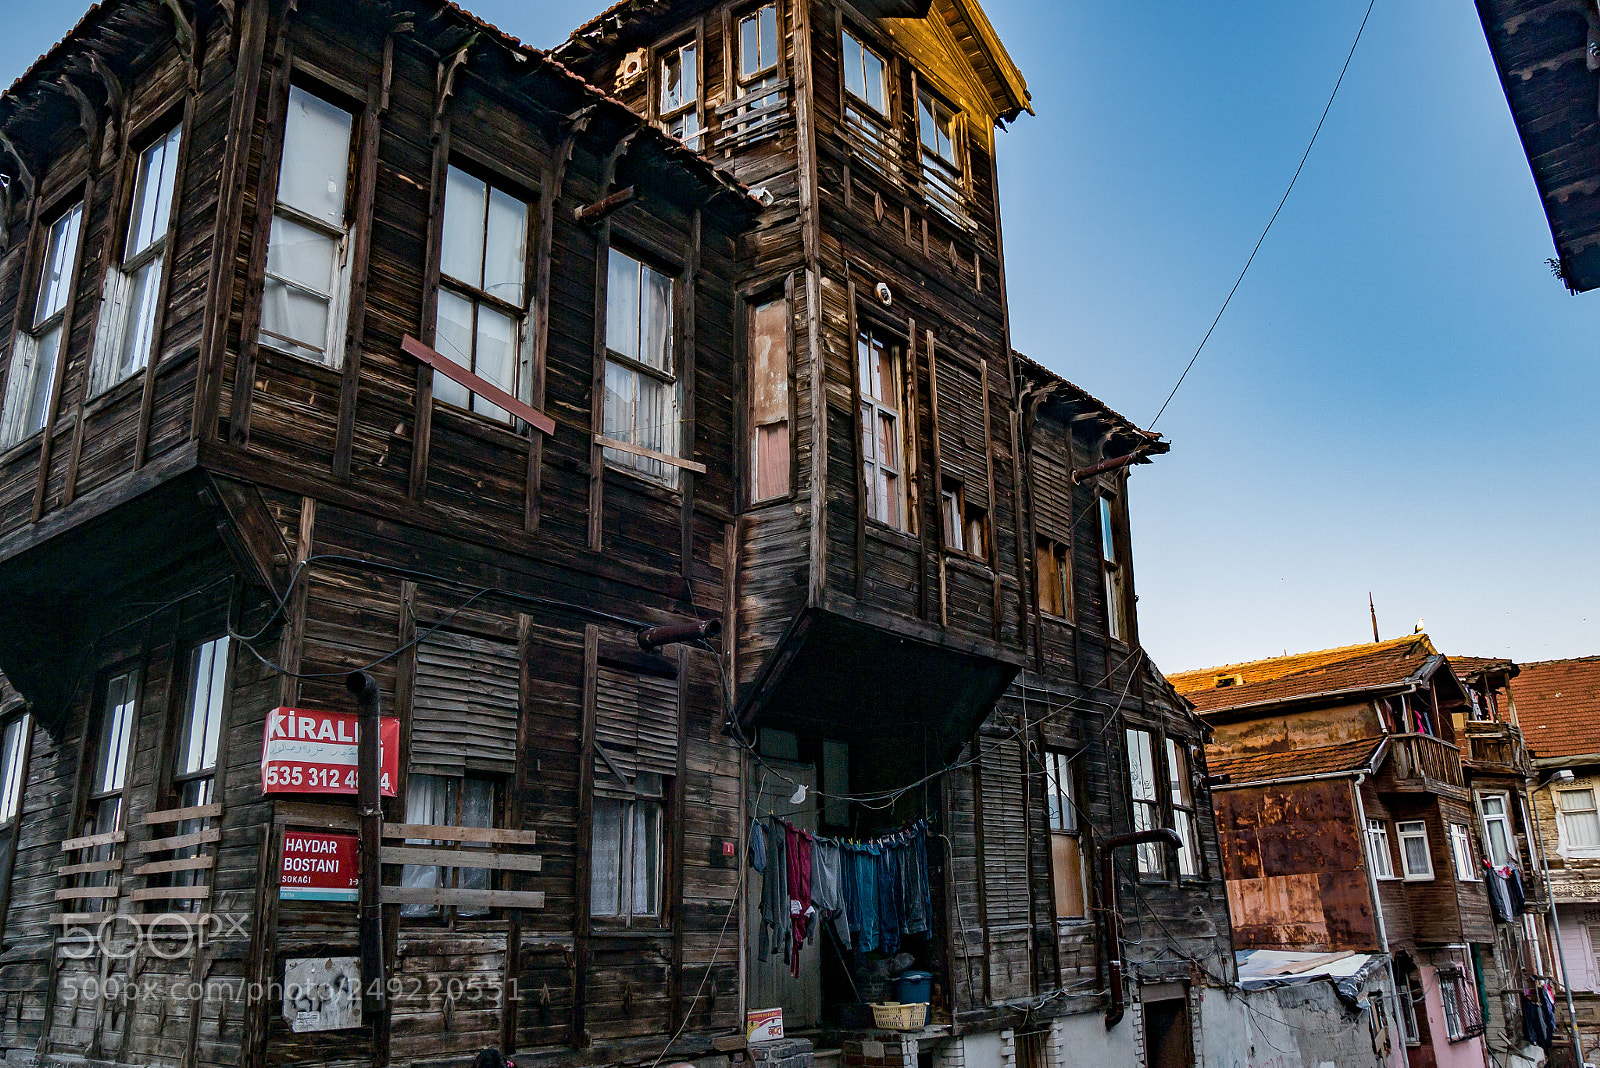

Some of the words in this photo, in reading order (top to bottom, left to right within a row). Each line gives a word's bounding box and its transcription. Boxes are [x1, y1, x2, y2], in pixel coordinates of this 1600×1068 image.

[269, 711, 383, 745] KİRALI
[267, 766, 303, 786] 535
[308, 768, 340, 788] 312
[285, 838, 338, 854] HAYDAR
[283, 857, 340, 873] BOSTANI
